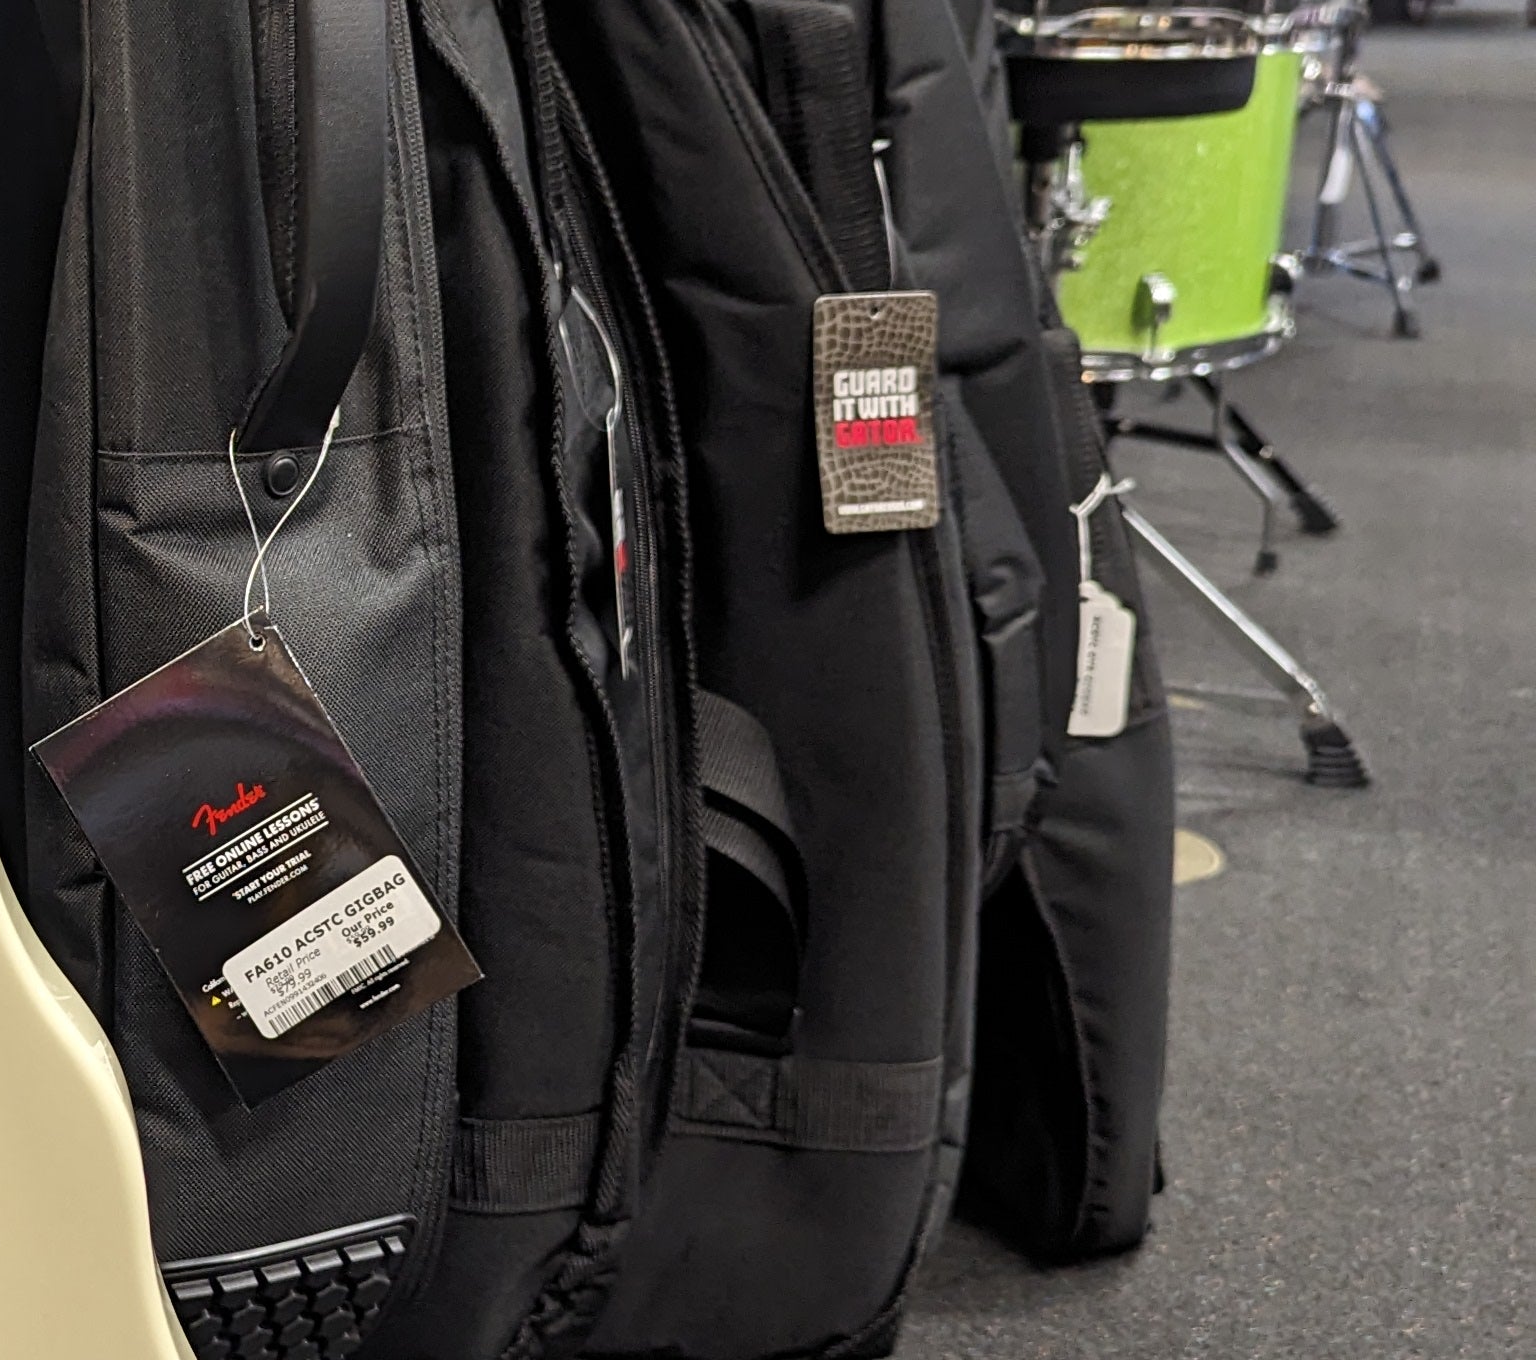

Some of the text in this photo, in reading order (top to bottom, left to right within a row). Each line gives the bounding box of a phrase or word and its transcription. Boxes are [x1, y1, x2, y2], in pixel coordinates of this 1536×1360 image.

[834, 366, 916, 397] GUARD
[833, 395, 918, 421] IT WITH
[192, 783, 267, 835] Fender
[185, 862, 216, 886] FREE
[214, 832, 265, 868] ONLINE
[193, 812, 325, 895] FOR GUITAR, BASS AND UKULELE
[261, 864, 286, 884] YOUR
[286, 849, 311, 868] TRIAL
[247, 864, 308, 904] PLAY.FENDER.COM
[245, 946, 293, 983] FA610
[293, 913, 344, 950] ACSTC
[344, 873, 406, 918] GIGBAG
[341, 920, 364, 938] Our
[364, 901, 394, 924] Price
[352, 916, 396, 948] $59.99
[265, 964, 295, 988] Retail
[295, 947, 321, 968] Price
